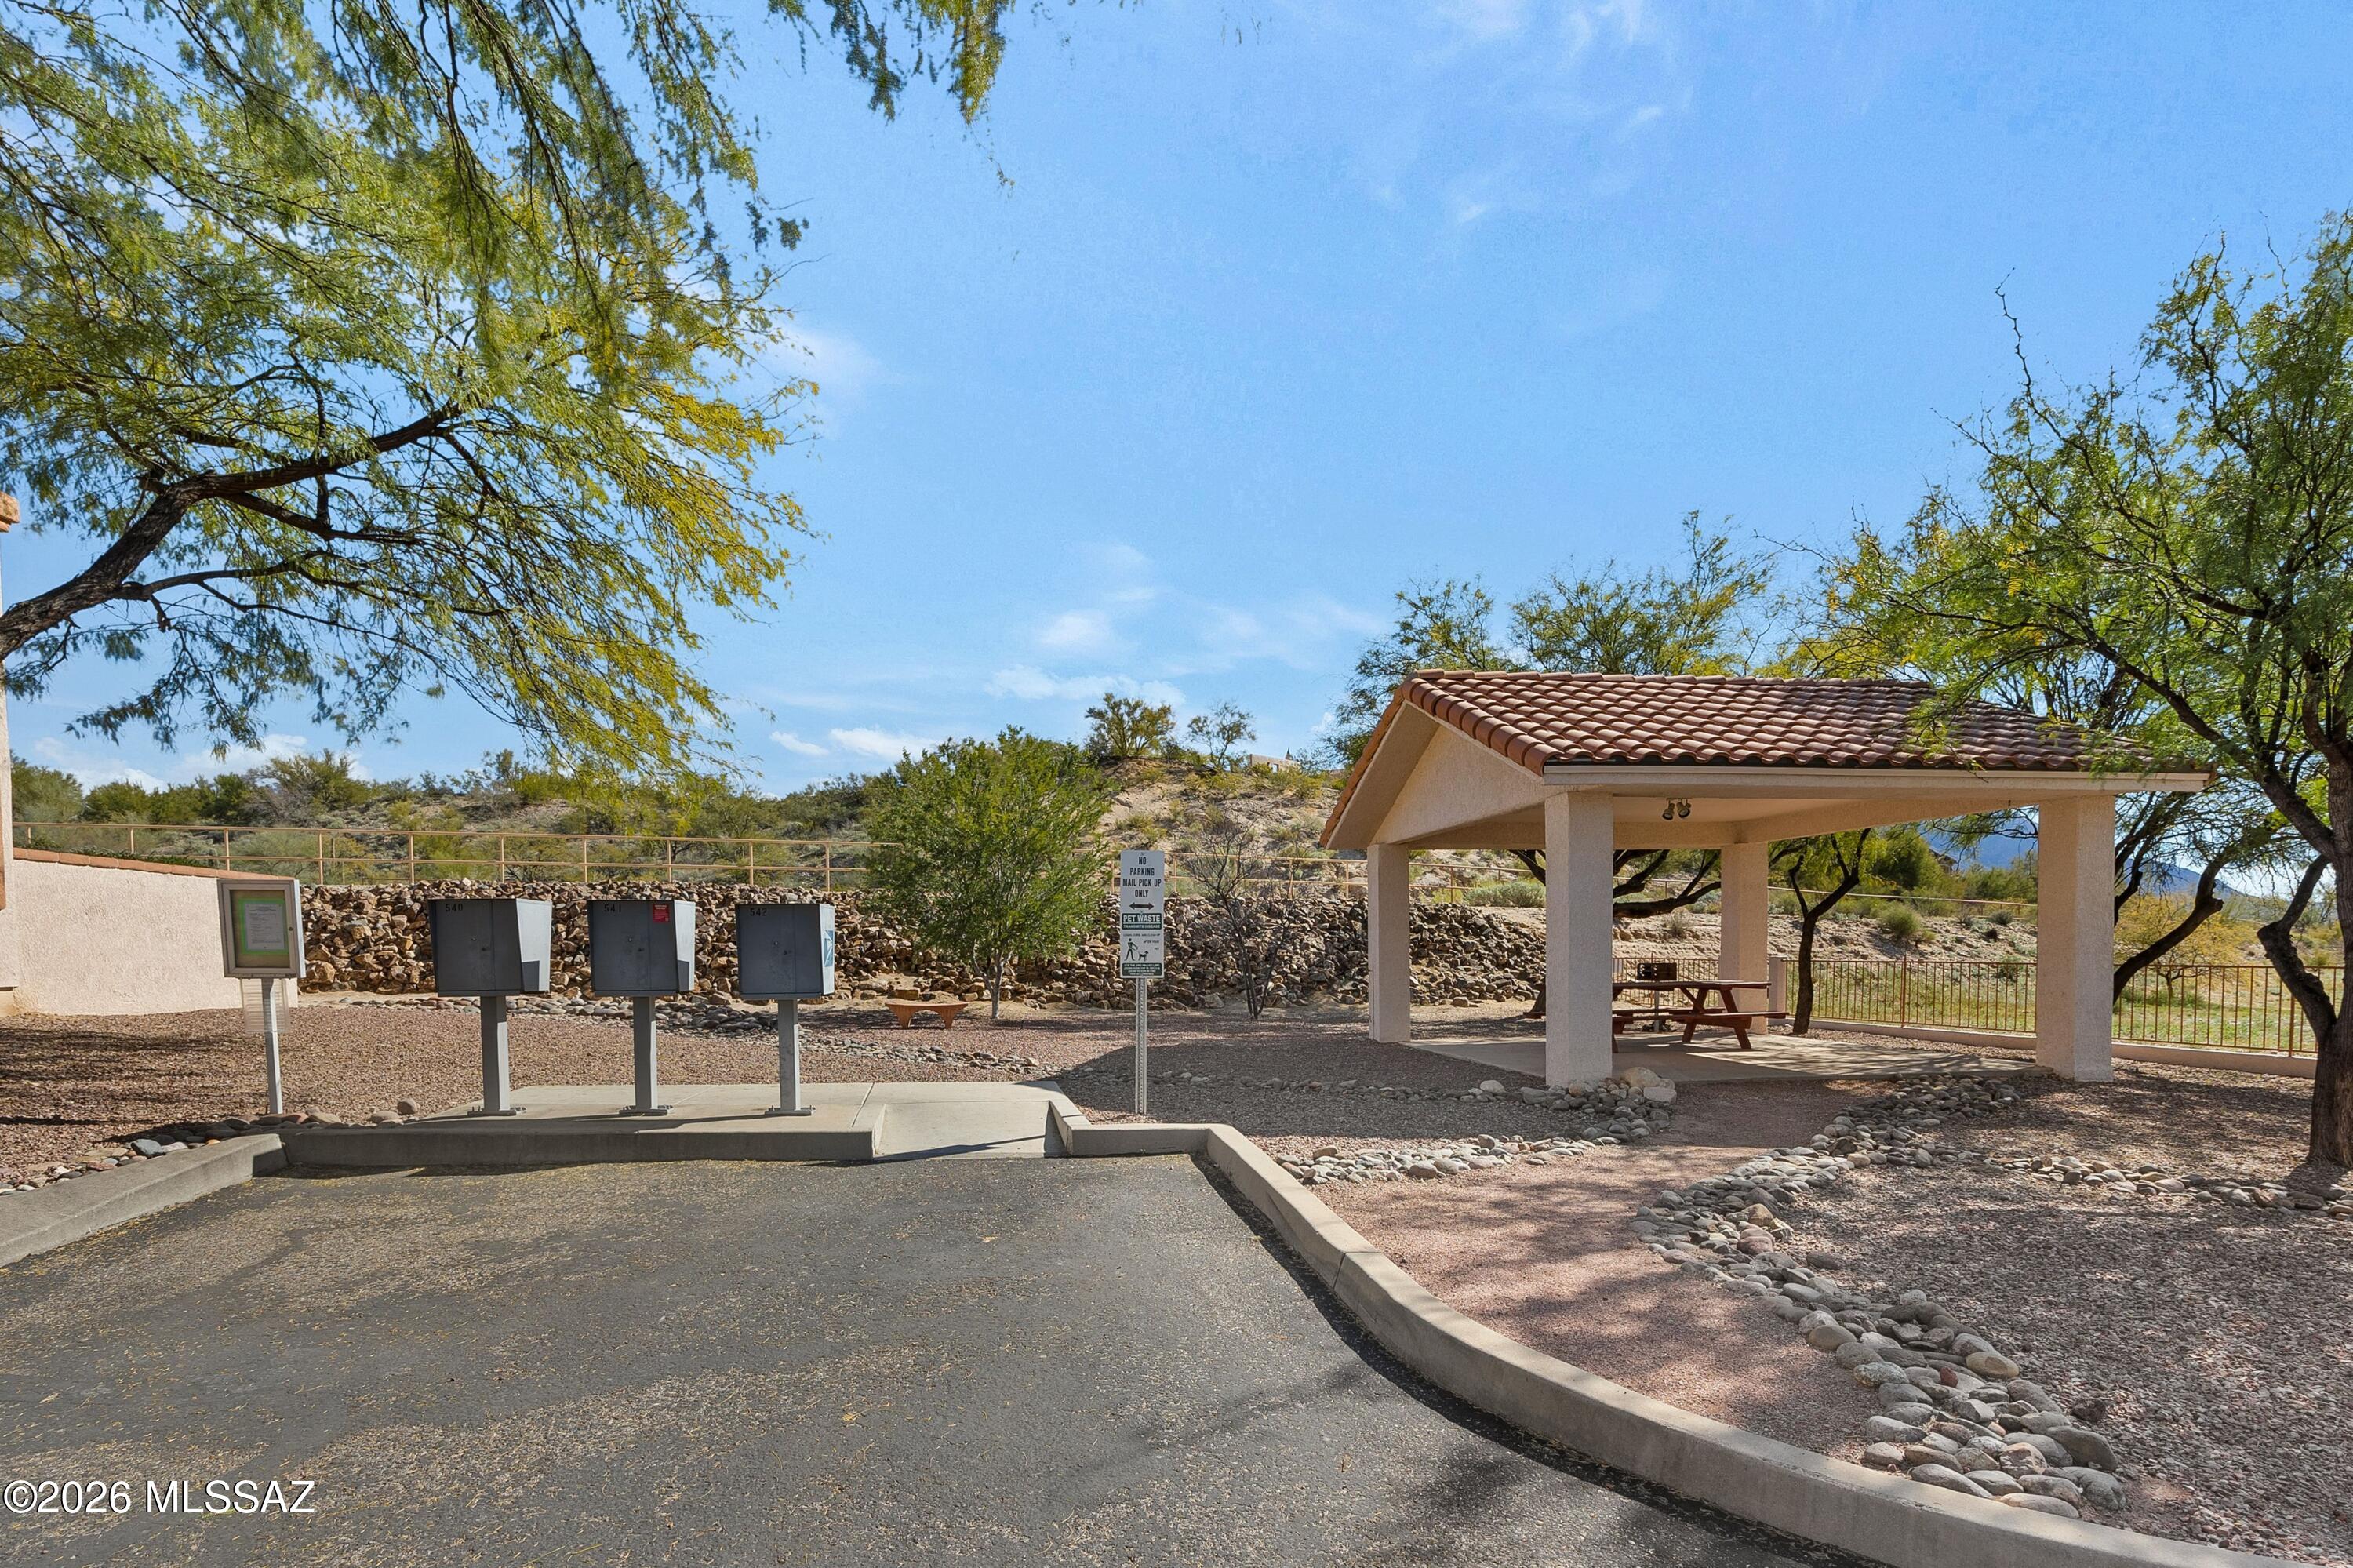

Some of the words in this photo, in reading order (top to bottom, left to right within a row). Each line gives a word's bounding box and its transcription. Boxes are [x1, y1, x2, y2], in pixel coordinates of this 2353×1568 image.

[1138, 857, 1147, 865] NO
[1129, 868, 1155, 876] PARKING
[1139, 879, 1151, 887] PICK
[1154, 879, 1162, 887] UP
[1134, 890, 1149, 898] ONLY
[445, 903, 464, 912] 540
[604, 903, 621, 913] 541
[750, 908, 767, 917] 542
